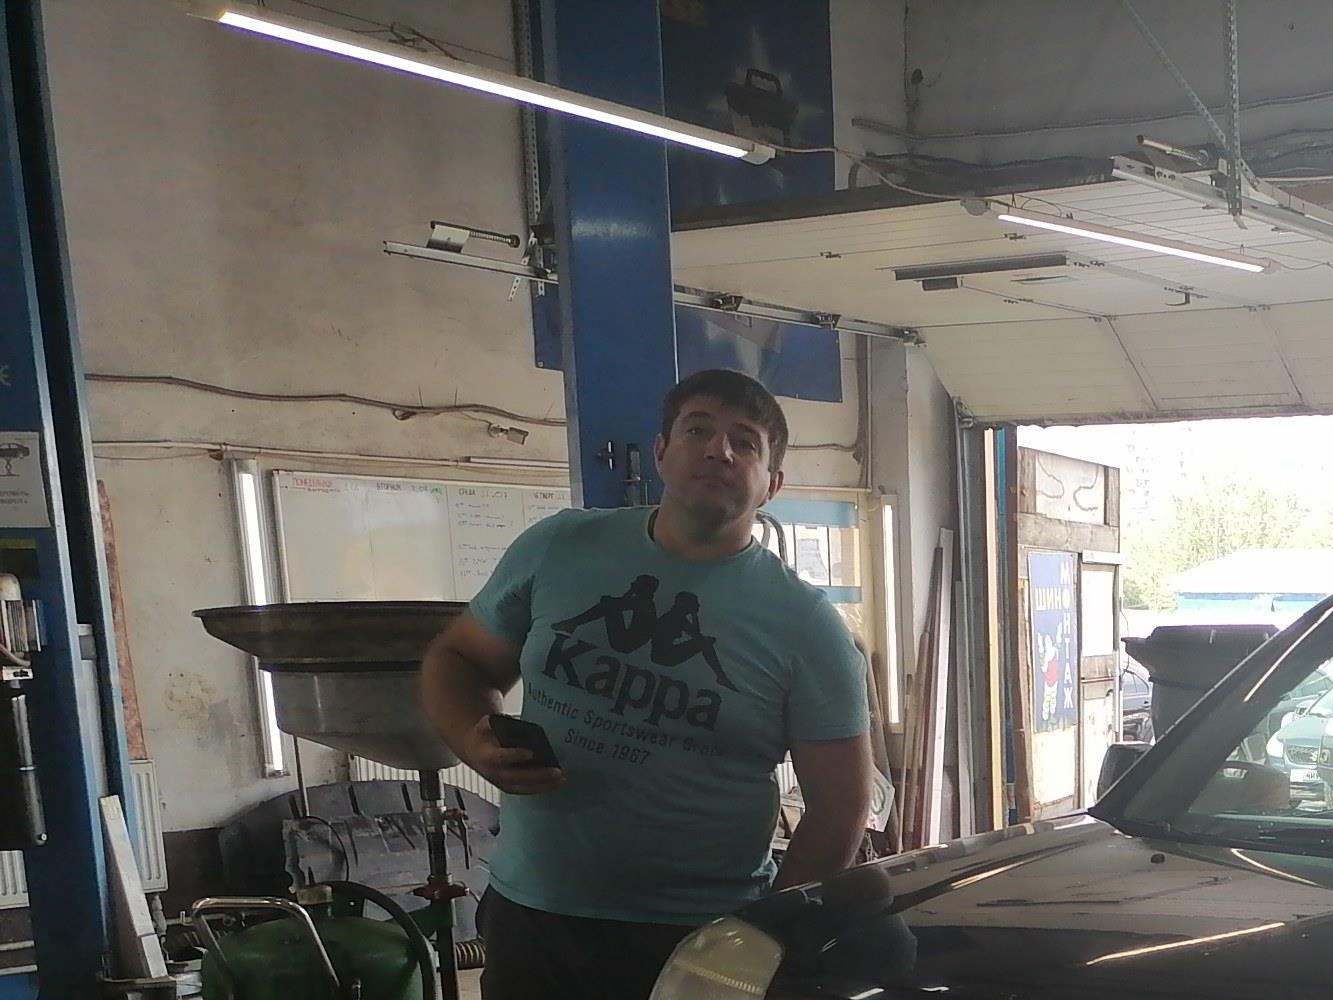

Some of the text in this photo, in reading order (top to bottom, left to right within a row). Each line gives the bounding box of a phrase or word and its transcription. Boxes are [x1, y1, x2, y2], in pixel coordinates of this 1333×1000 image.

[541, 633, 722, 731] Kappa
[564, 726, 608, 756] Since
[611, 742, 652, 766] 1967
[584, 710, 674, 748] Sportswear
